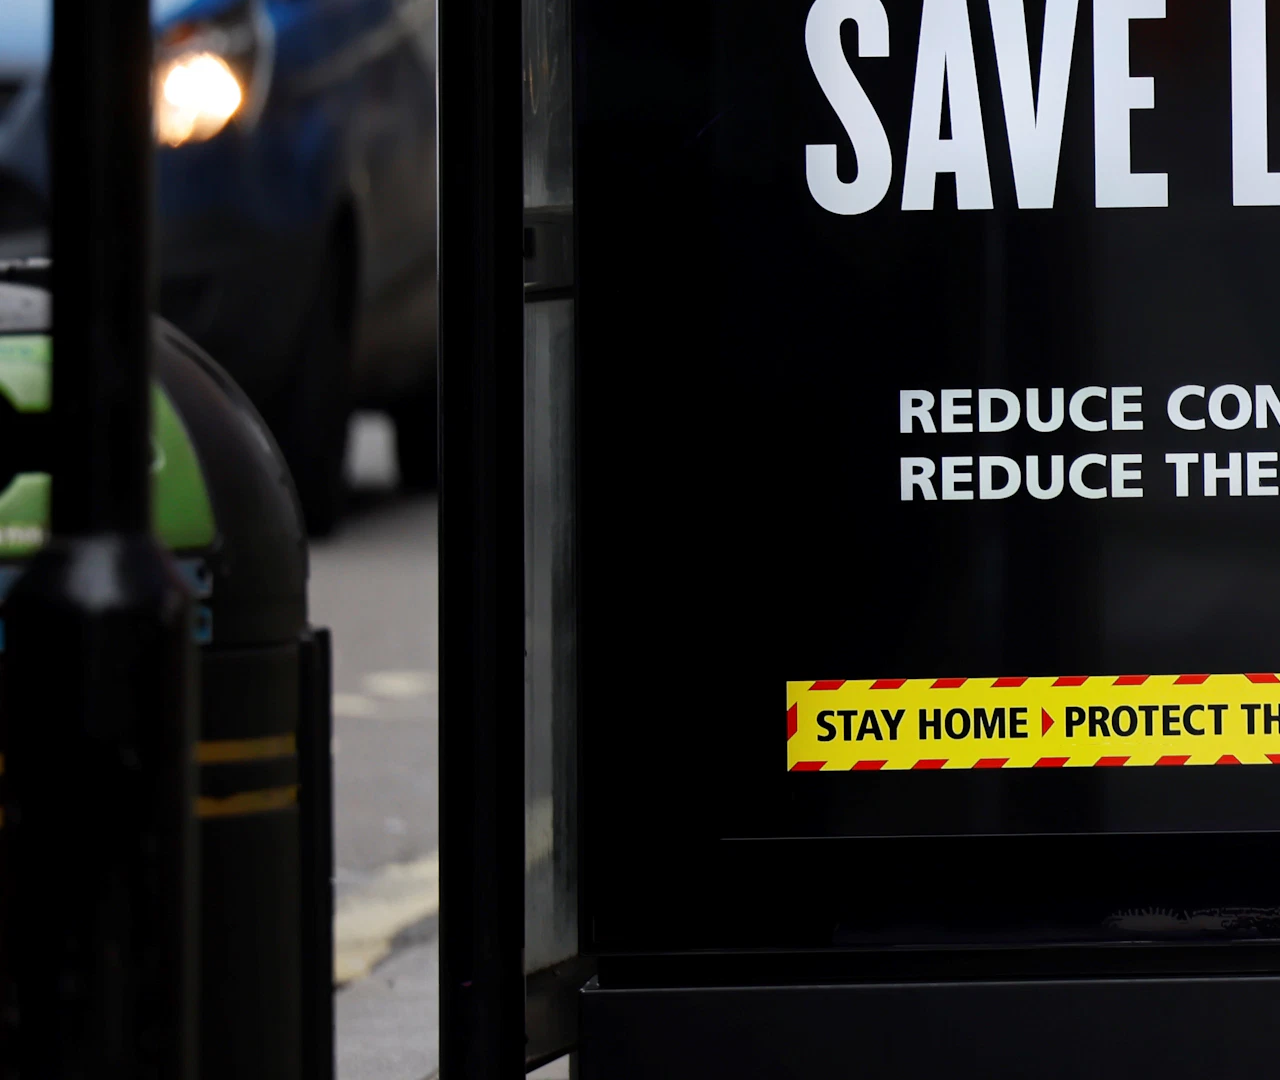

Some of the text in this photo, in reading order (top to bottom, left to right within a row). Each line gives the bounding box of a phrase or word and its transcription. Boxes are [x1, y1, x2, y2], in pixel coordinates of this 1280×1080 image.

[899, 386, 1144, 434] REDUCE
[900, 453, 1144, 501] REDUCE
[1166, 451, 1279, 497] THE
[816, 709, 906, 742] STAY
[918, 707, 1028, 740] HOME
[1065, 704, 1229, 738] PROTECT
